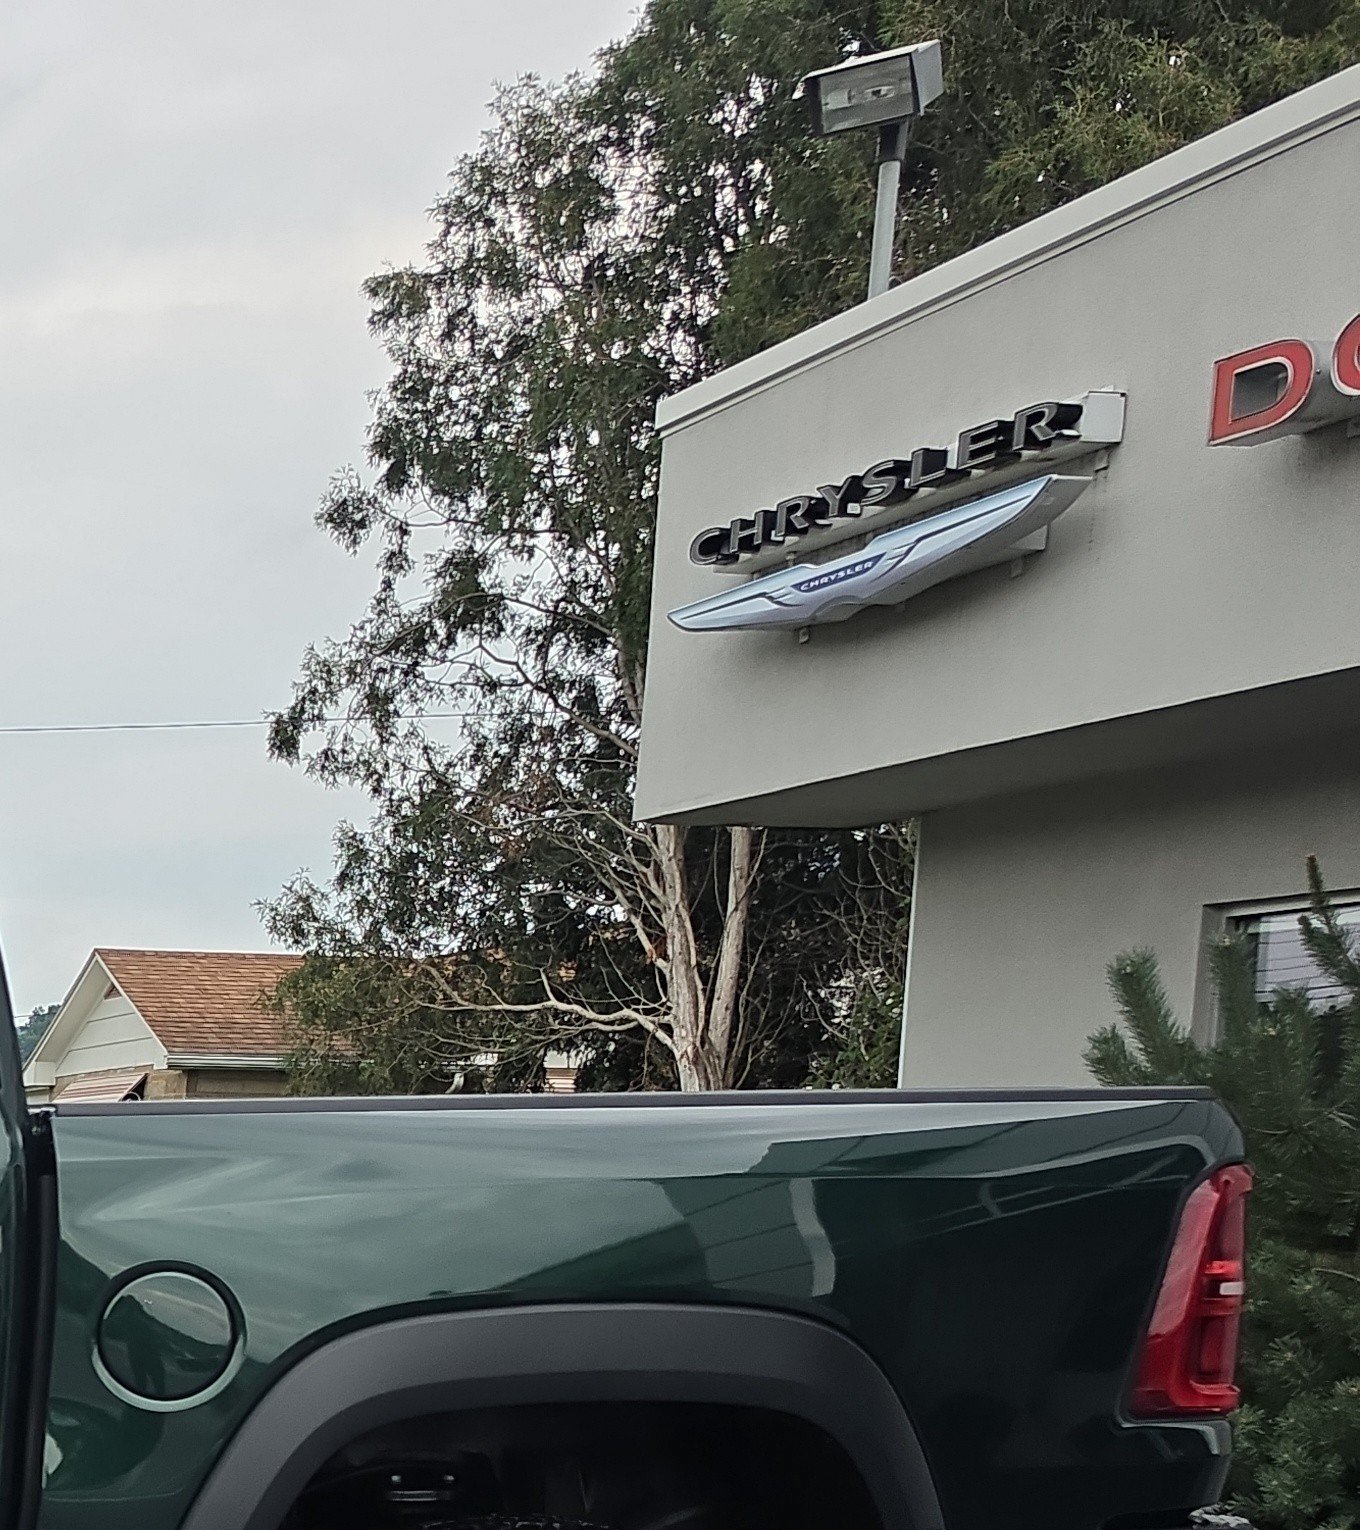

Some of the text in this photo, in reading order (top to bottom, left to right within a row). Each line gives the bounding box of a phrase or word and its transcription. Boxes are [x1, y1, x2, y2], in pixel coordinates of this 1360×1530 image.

[1208, 313, 1359, 445] D
[688, 401, 1068, 566] CHRYSLER
[800, 561, 874, 591] CHRYSLER
